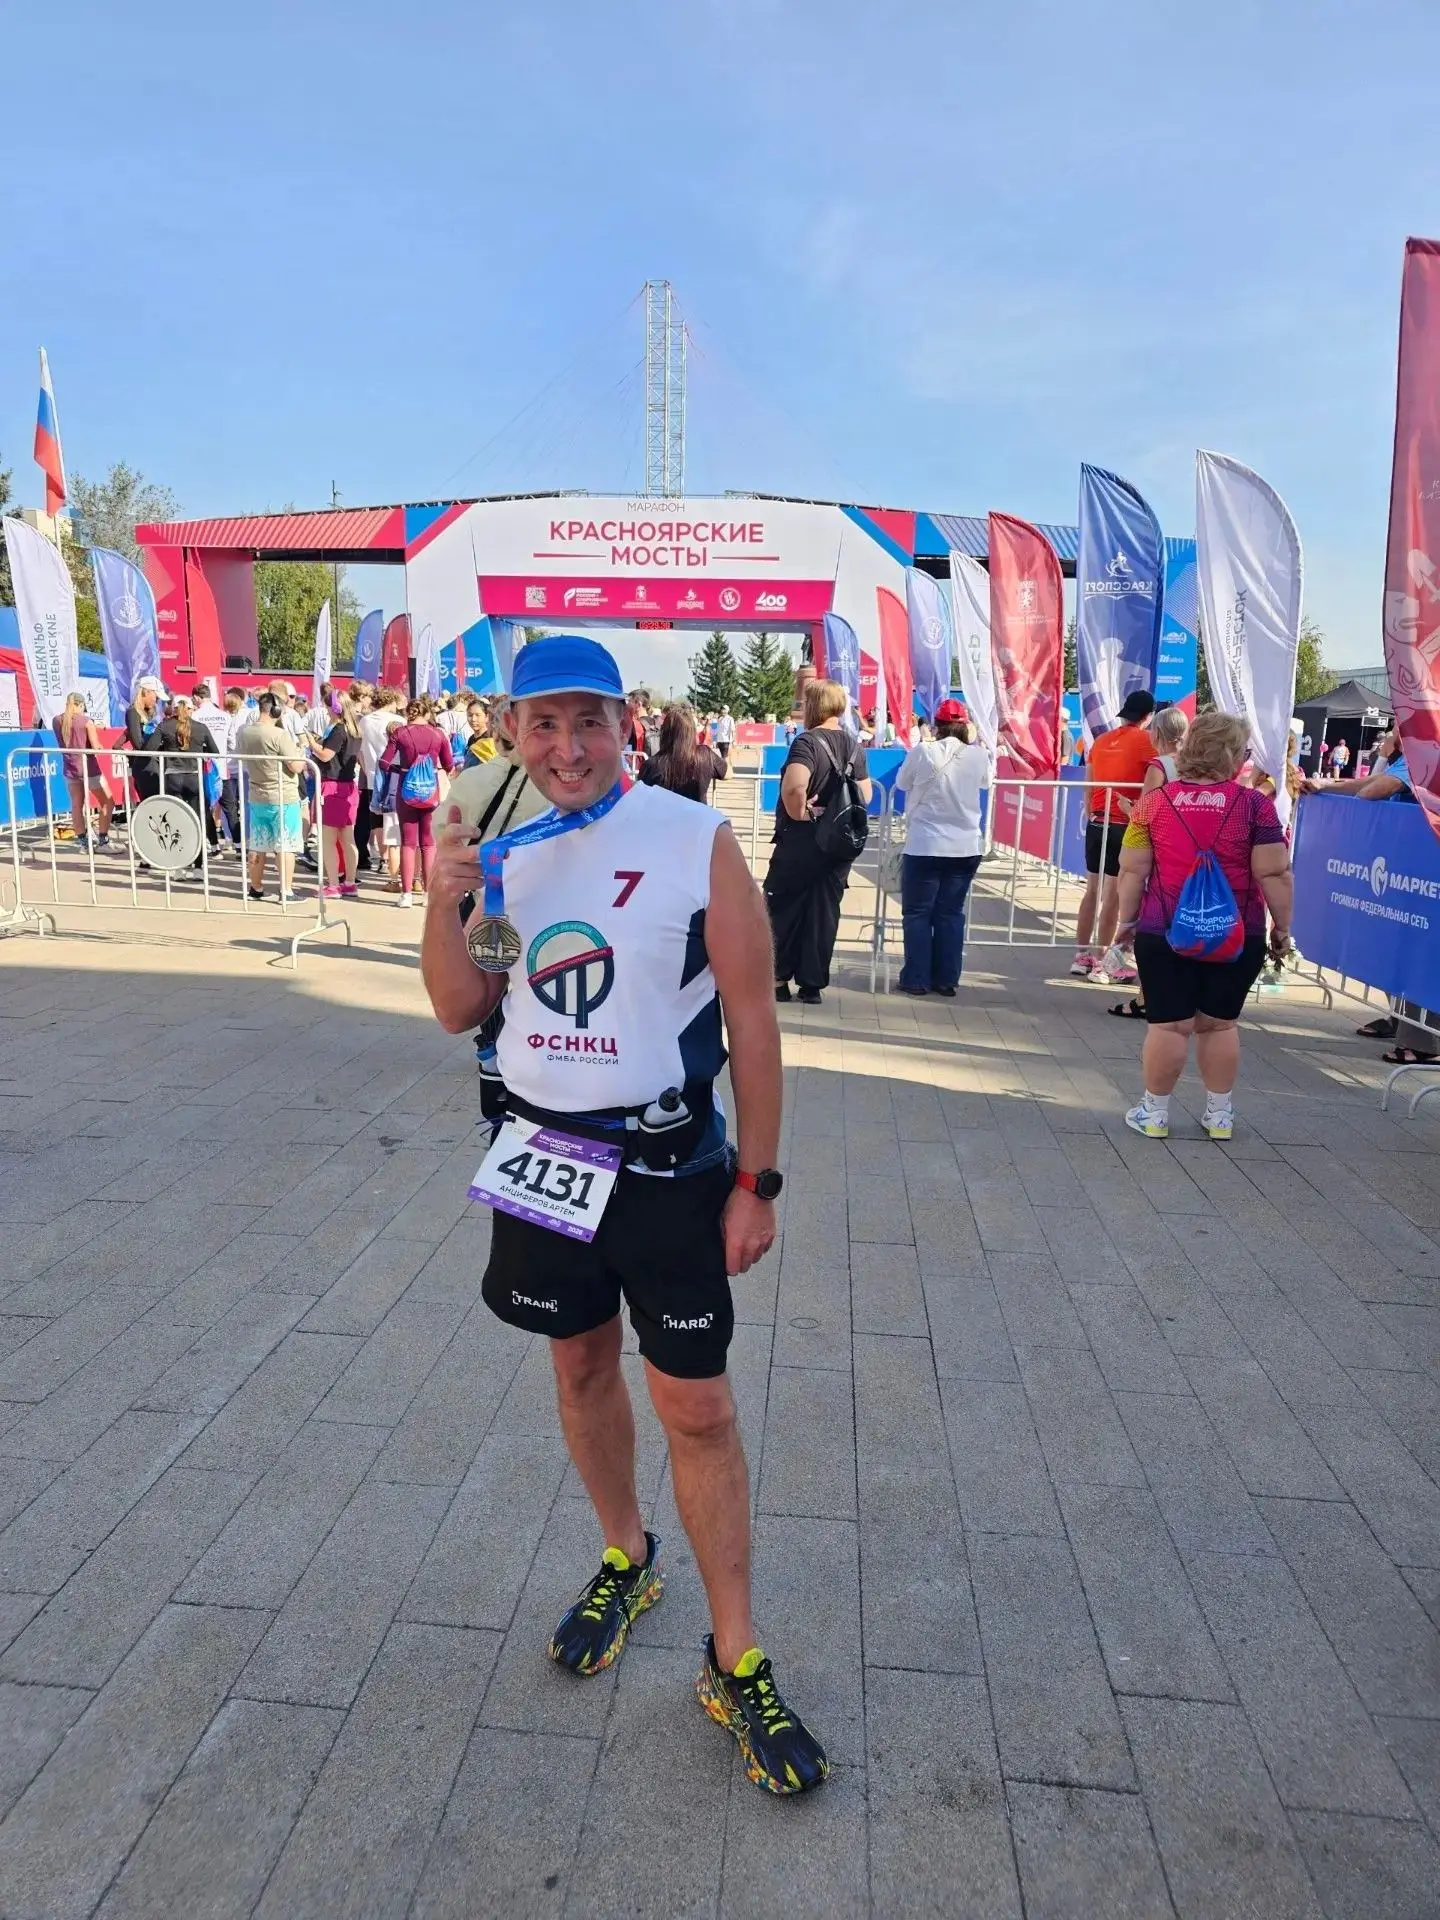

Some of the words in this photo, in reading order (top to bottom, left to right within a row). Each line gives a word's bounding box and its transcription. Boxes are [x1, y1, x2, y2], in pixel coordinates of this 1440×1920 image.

[627, 502, 685, 513] МАРАФОН
[550, 521, 764, 543] КРАСНОЯРСКИЕ
[611, 546, 707, 567] МОСТЫ
[755, 591, 788, 607] 400
[1327, 858, 1370, 881] СПАРТА
[612, 871, 645, 907] 7
[1360, 900, 1409, 924] ФЕДЕРАЛЬНАЯ
[1410, 914, 1429, 930] СЕТЬ
[527, 1033, 618, 1056] ФСНКЦ
[547, 1054, 576, 1062] ФМБА
[580, 1056, 619, 1065] РОССИИ
[497, 1152, 596, 1211] 4131
[500, 1185, 549, 1208] АНЦИФЕРОВ
[549, 1203, 576, 1218] АРТЕМ
[516, 1294, 555, 1310] TRAIN
[668, 1318, 708, 1330] HARD
